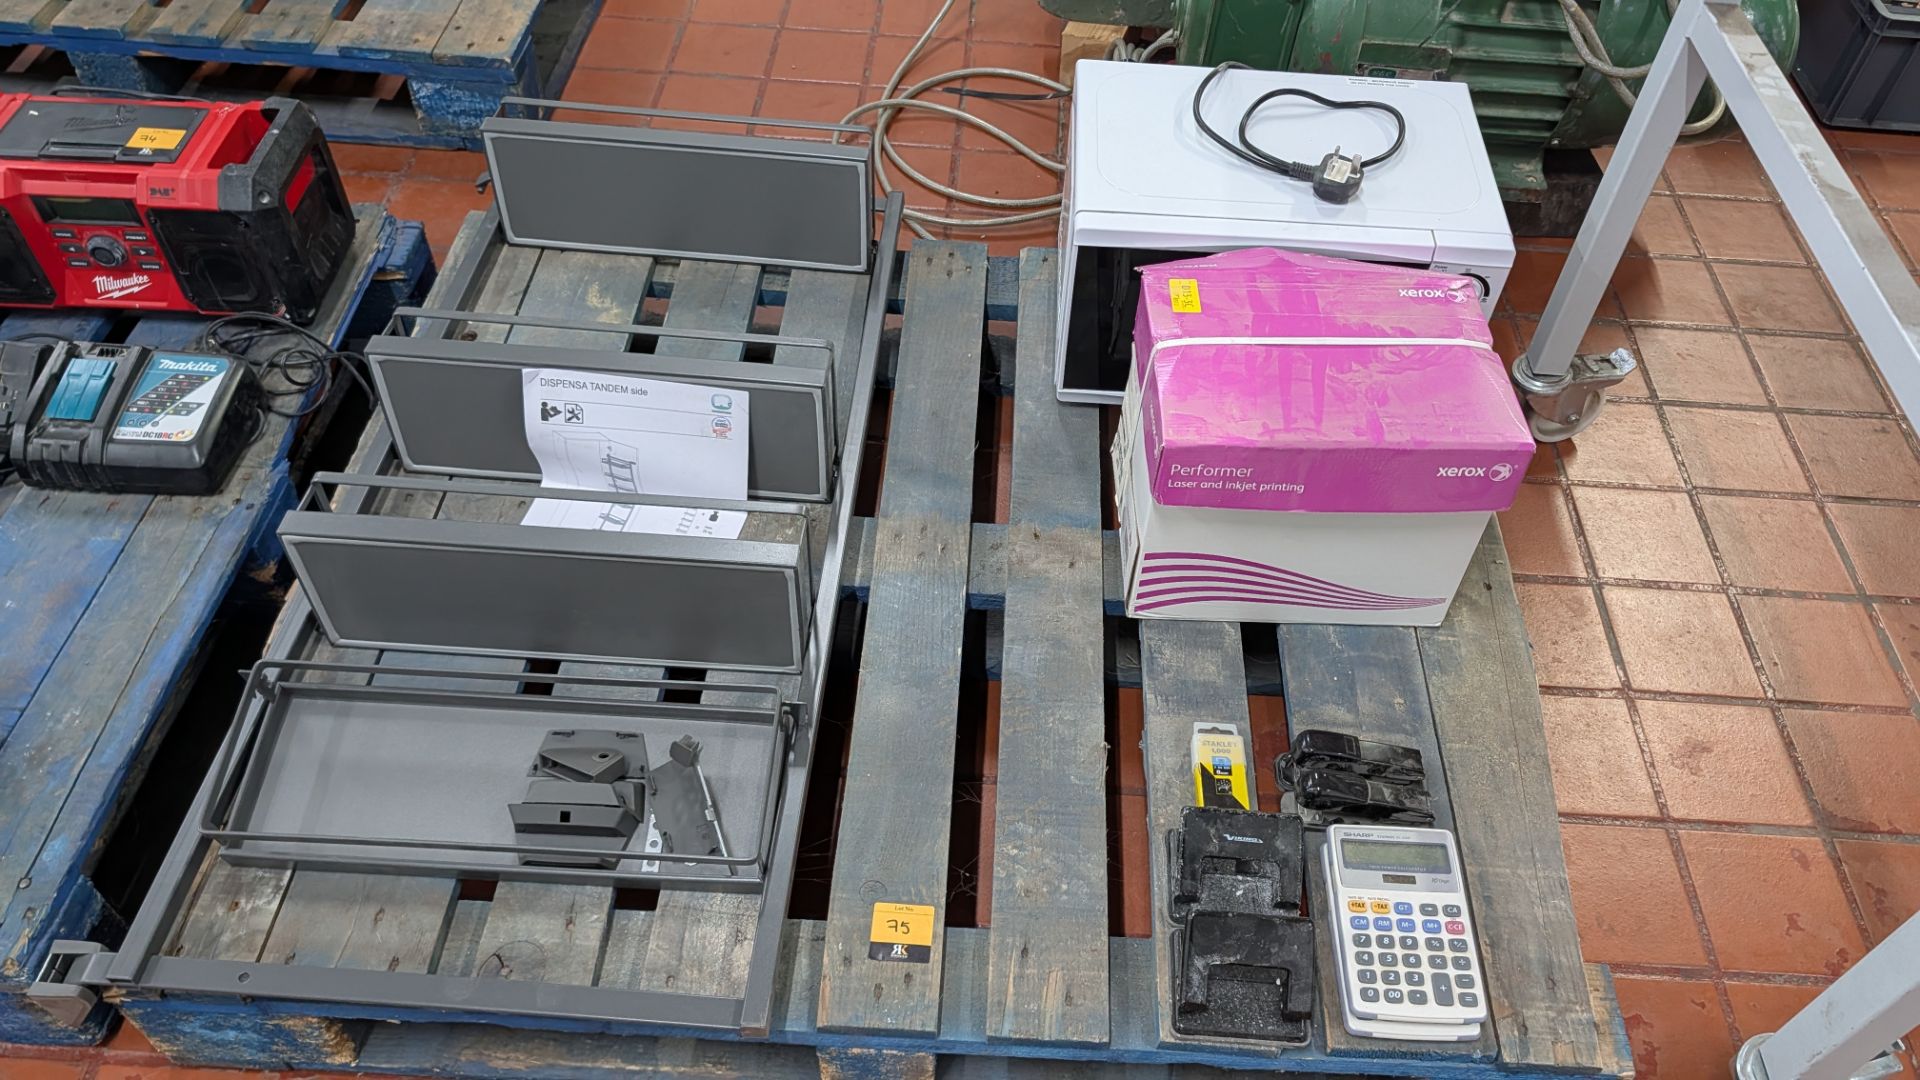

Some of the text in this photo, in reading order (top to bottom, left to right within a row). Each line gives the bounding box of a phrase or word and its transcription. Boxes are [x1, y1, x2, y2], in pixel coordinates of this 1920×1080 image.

[139, 134, 157, 143] 74
[92, 273, 151, 294] Milwaukee
[1398, 287, 1444, 298] xerox
[539, 377, 648, 396] DISPENSA TANDEM side
[142, 431, 174, 440] DC18RC
[1169, 463, 1254, 478] Performer
[1436, 465, 1486, 477] xerox
[1167, 479, 1305, 495] Laser and inkjet printing
[1202, 740, 1238, 748] STANLEY
[1223, 833, 1258, 843] VIKING
[886, 919, 911, 935] 75
[1354, 918, 1367, 926] CM
[1360, 935, 1366, 943] 7
[1406, 938, 1412, 946] 9
[1362, 953, 1368, 961] 4
[1367, 989, 1374, 997] 0
